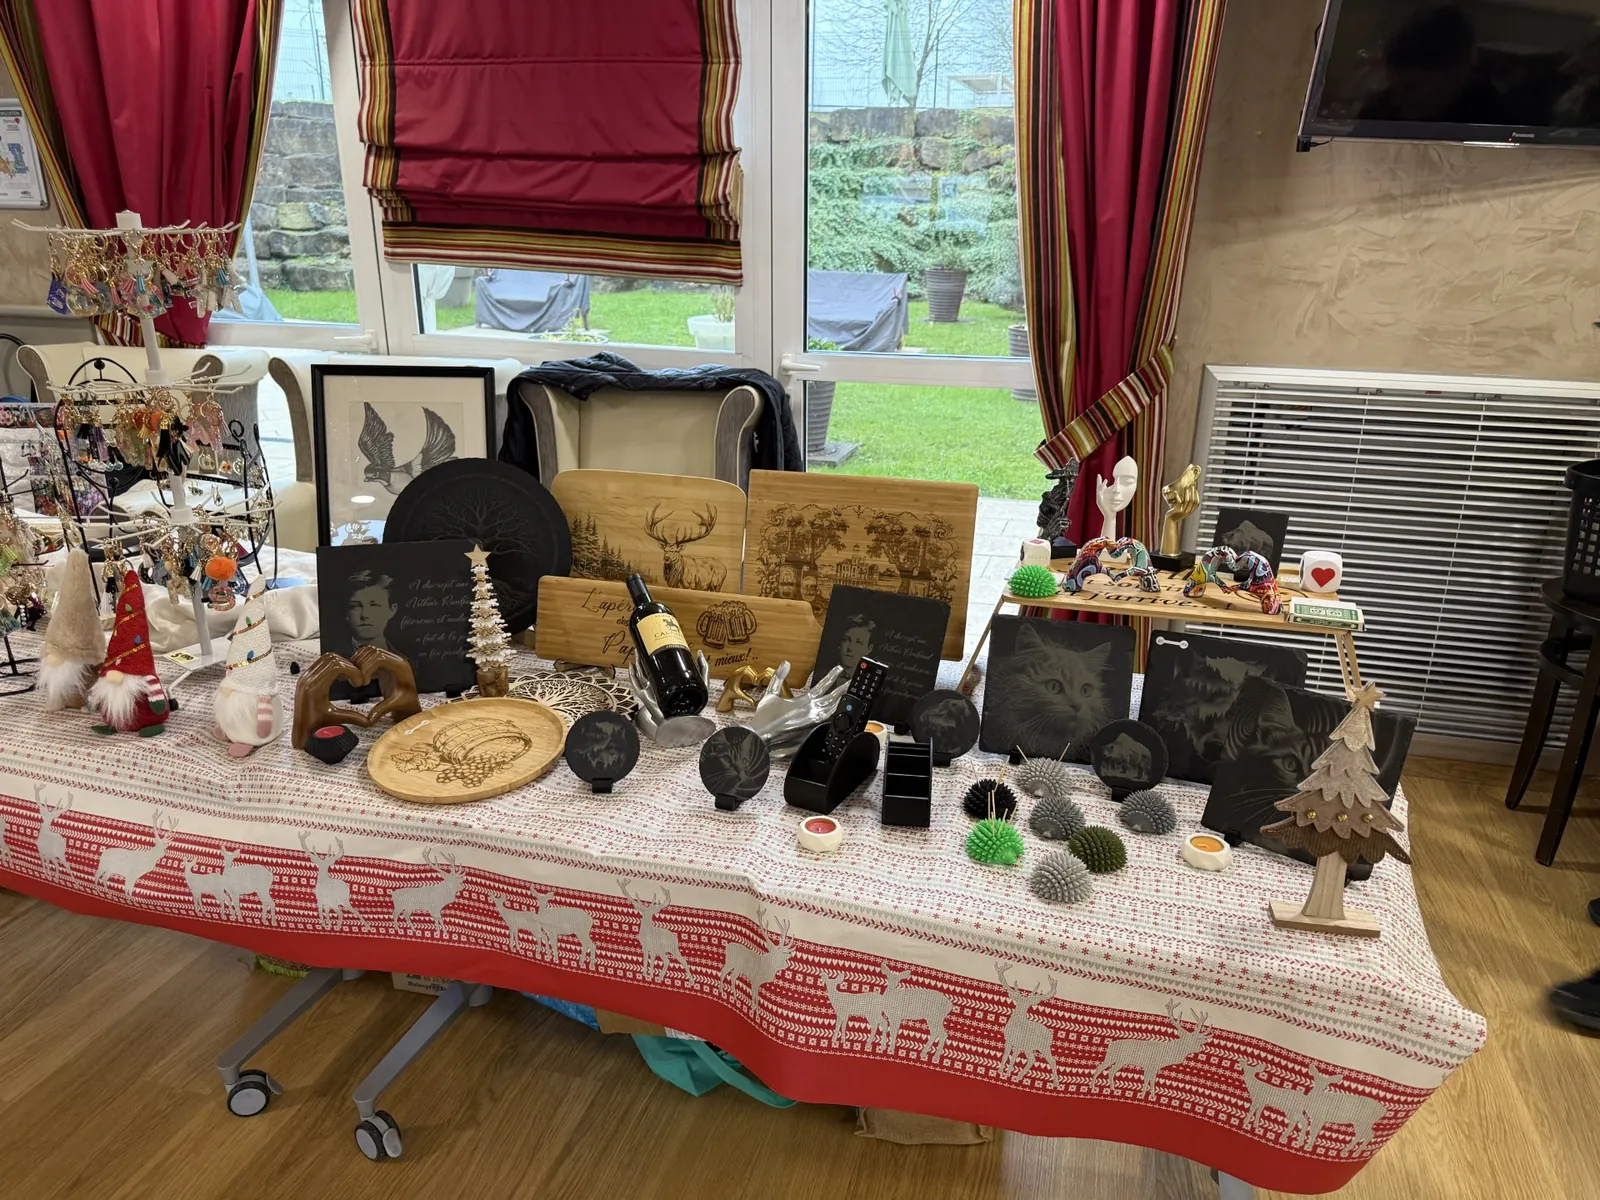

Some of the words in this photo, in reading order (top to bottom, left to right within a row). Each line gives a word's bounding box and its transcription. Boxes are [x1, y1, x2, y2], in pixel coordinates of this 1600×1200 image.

[581, 587, 635, 619] L'apér
[616, 616, 630, 627] c'es
[603, 630, 635, 664] Pap
